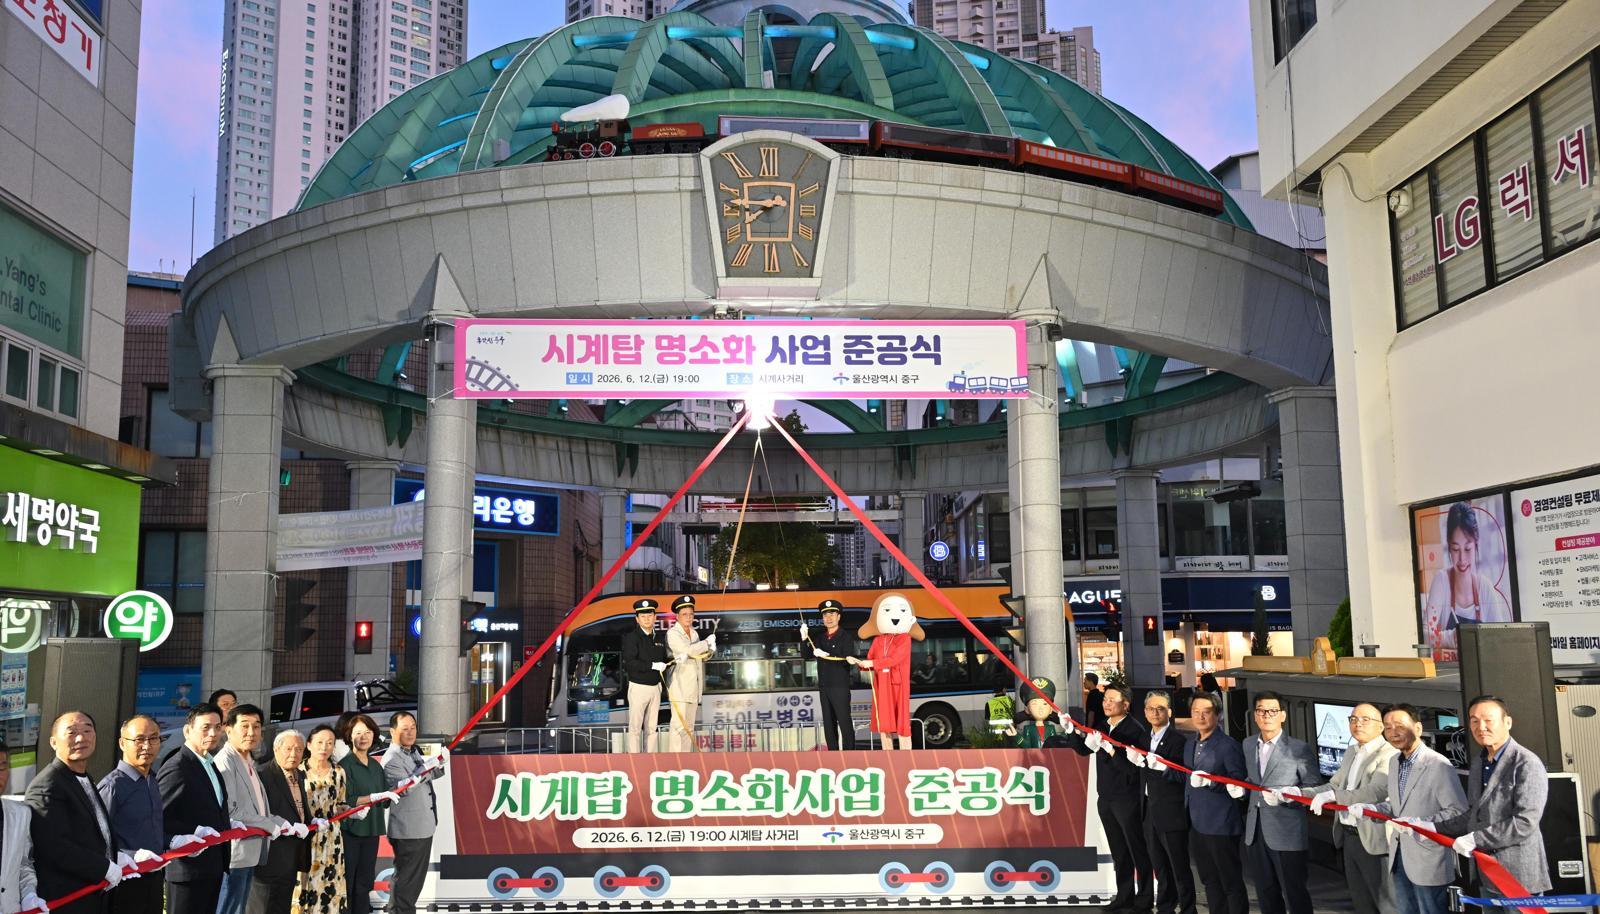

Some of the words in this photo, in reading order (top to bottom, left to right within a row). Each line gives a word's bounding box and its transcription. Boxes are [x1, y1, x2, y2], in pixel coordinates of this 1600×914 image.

[219, 48, 229, 137] EXORDIUM
[1434, 195, 1482, 265] LG
[28, 300, 63, 333] Clinic
[541, 334, 645, 365] 시계탑
[655, 334, 756, 365] 명소화
[765, 334, 832, 366] 사업
[843, 334, 942, 366] 준공식
[597, 374, 623, 384] 2026.
[626, 375, 635, 384] 6.
[673, 375, 700, 384] 19:00
[758, 374, 804, 385] 시계사거리
[852, 374, 898, 385] 울산광역시
[901, 374, 920, 385] 중구
[1533, 494, 1573, 513] 경영컨설팅
[2, 492, 100, 554] 세명약국
[115, 600, 159, 642] 약
[737, 621, 762, 630] ZERO
[1551, 636, 1567, 650] 바일
[713, 708, 815, 731] 하이본병원
[489, 774, 631, 819] 시계탑
[653, 770, 882, 816] 명소화사업
[908, 768, 1048, 814] 준공식
[591, 832, 629, 843] 2026.
[631, 832, 642, 843] 6.
[647, 830, 685, 843] 12.(금)
[689, 830, 726, 842] 19:00
[729, 829, 763, 842] 시계탑
[765, 829, 799, 841] 사거리
[849, 828, 900, 841] 울산광역시
[904, 828, 925, 840] 중구
